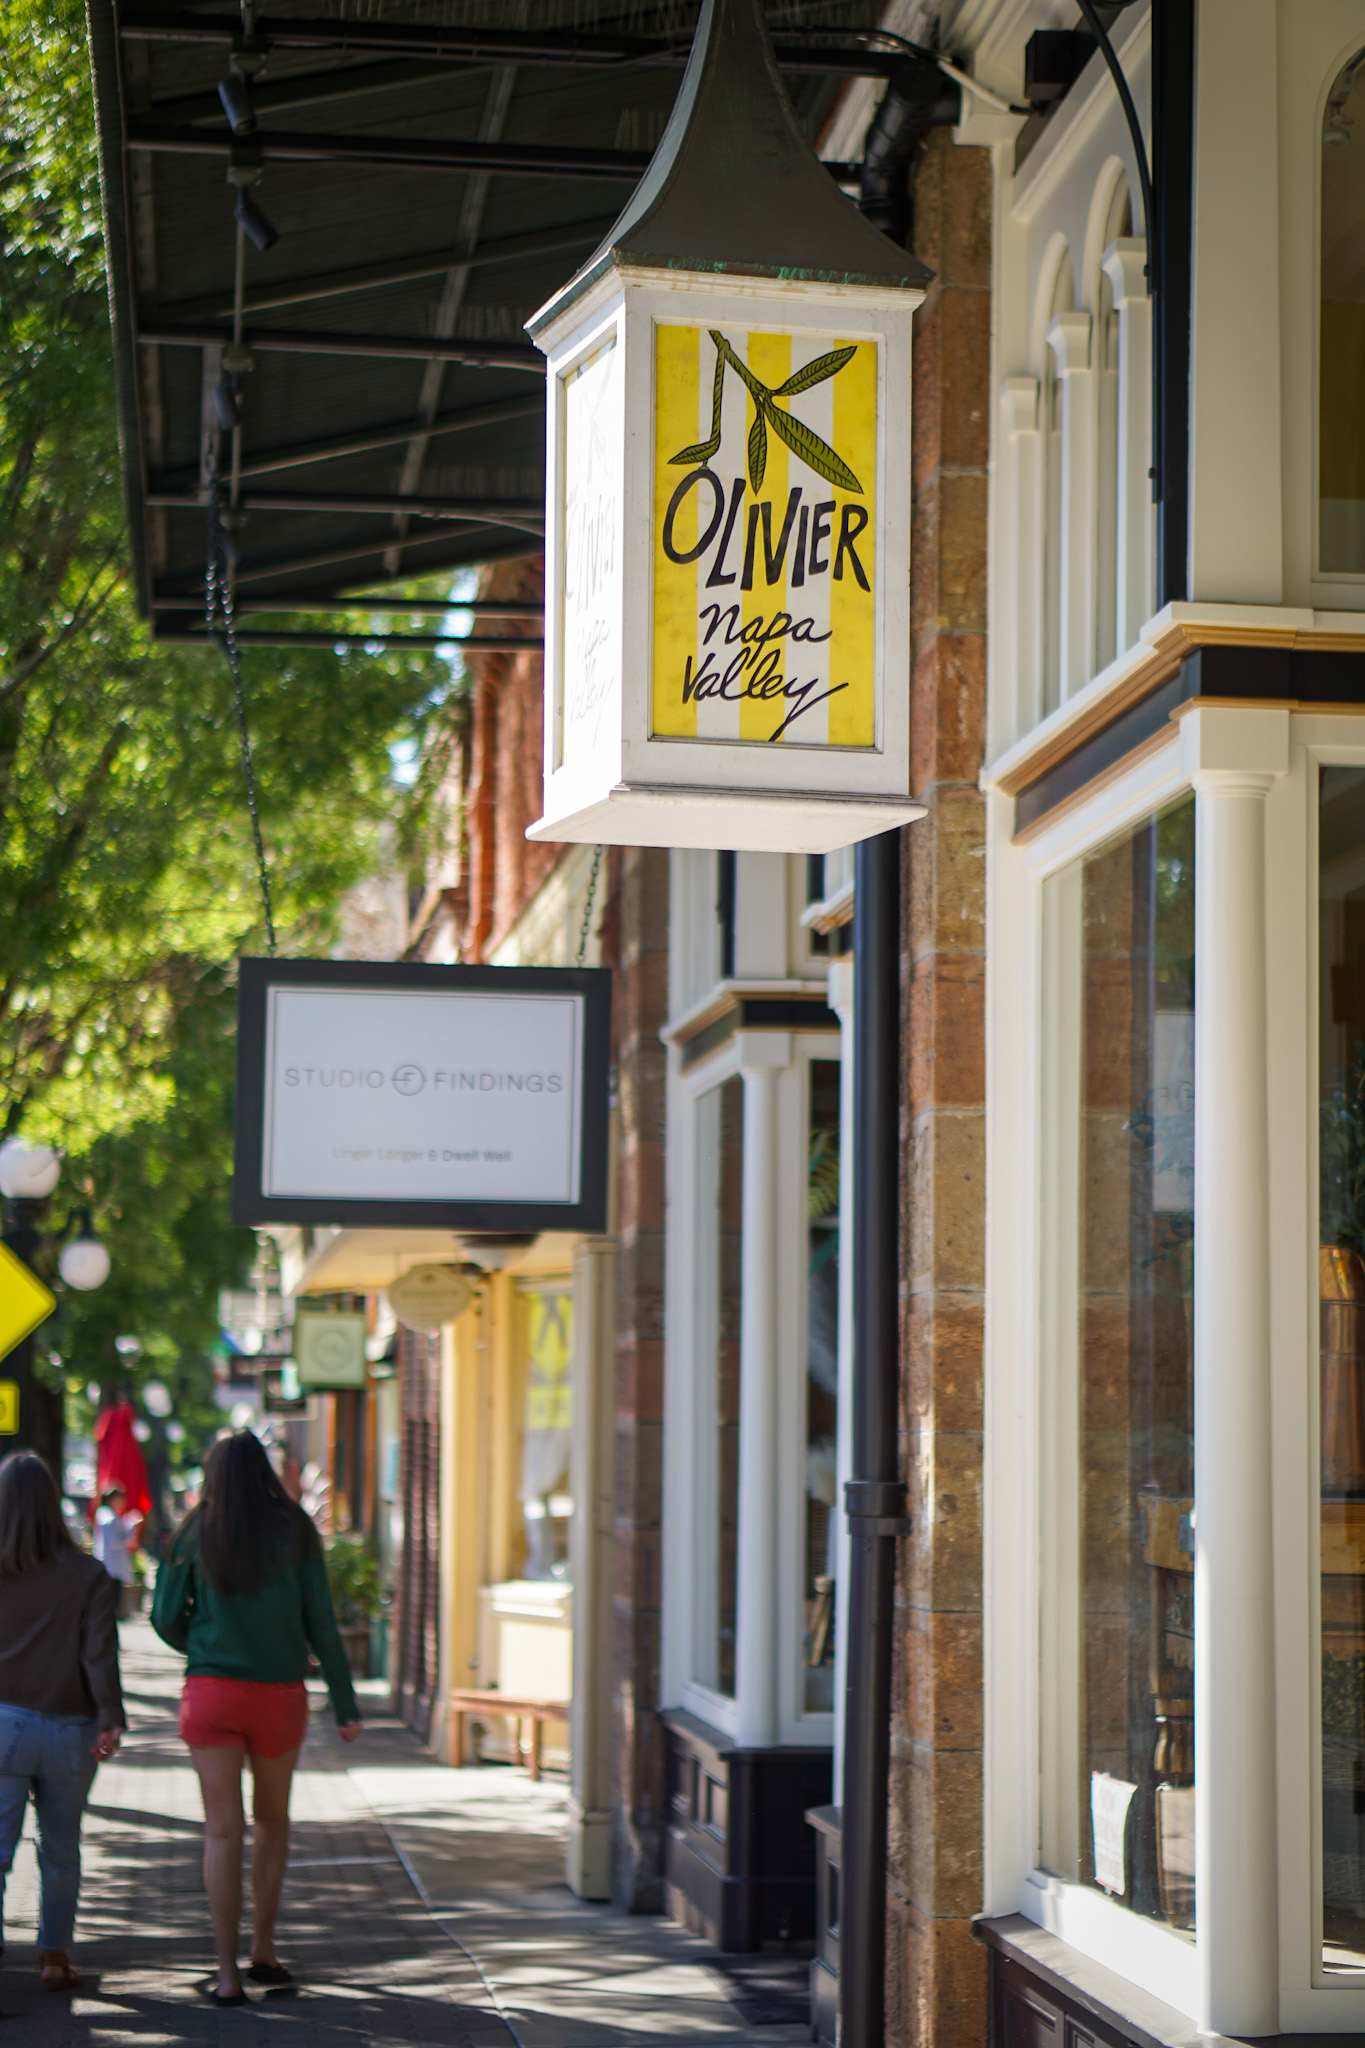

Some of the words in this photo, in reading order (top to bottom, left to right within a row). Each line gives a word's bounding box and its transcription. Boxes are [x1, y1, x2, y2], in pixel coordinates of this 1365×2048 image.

[663, 468, 871, 592] OLIVIER
[682, 647, 849, 742] Valley
[284, 1068, 385, 1089] STUDIO
[433, 1071, 563, 1094] FINDINGS
[442, 1149, 479, 1162] Dwell
[483, 1149, 512, 1162] Well
